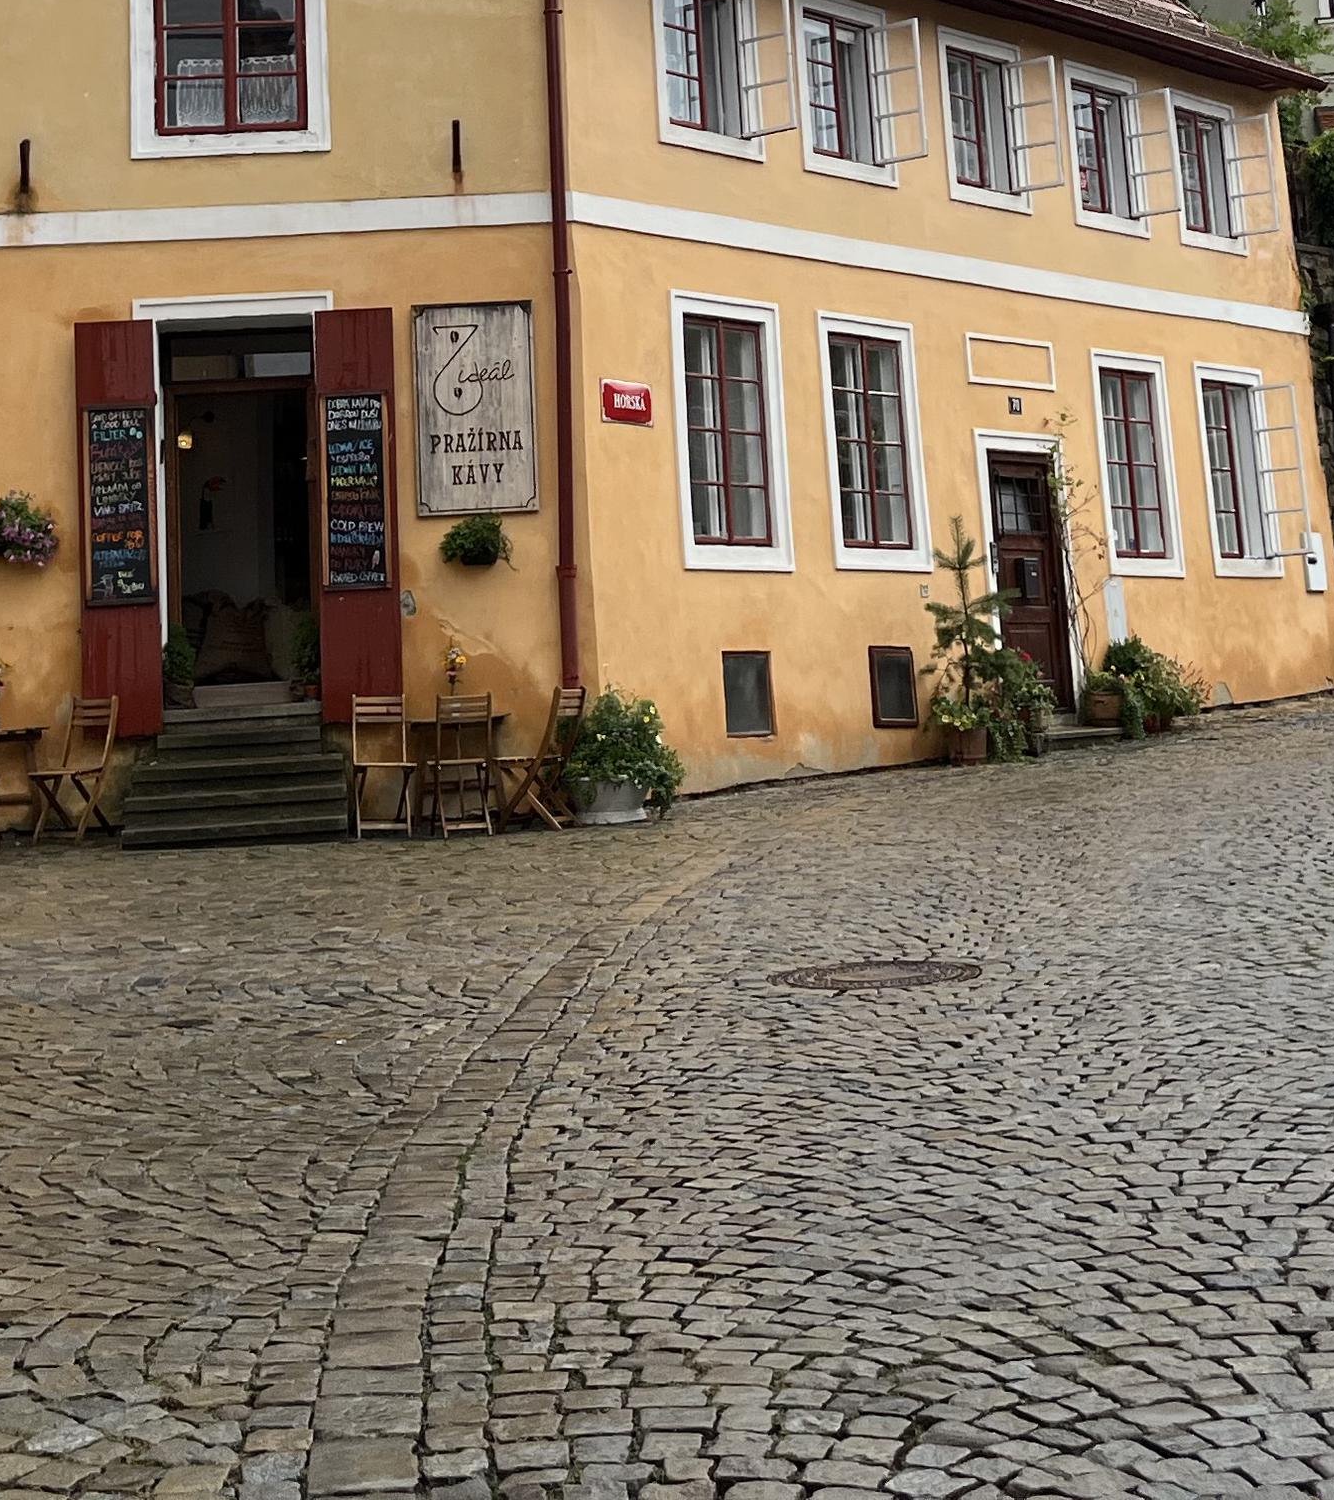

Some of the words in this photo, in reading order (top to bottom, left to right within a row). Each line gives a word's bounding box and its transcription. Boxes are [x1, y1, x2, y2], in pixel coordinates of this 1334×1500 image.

[458, 358, 515, 384] ideál
[613, 392, 647, 411] HORSKÁ
[93, 429, 128, 441] FILTER
[430, 427, 524, 454] PRAŽÍRNA
[451, 459, 505, 486] KÁVY
[330, 518, 356, 531] COLD
[358, 520, 384, 533] BREW
